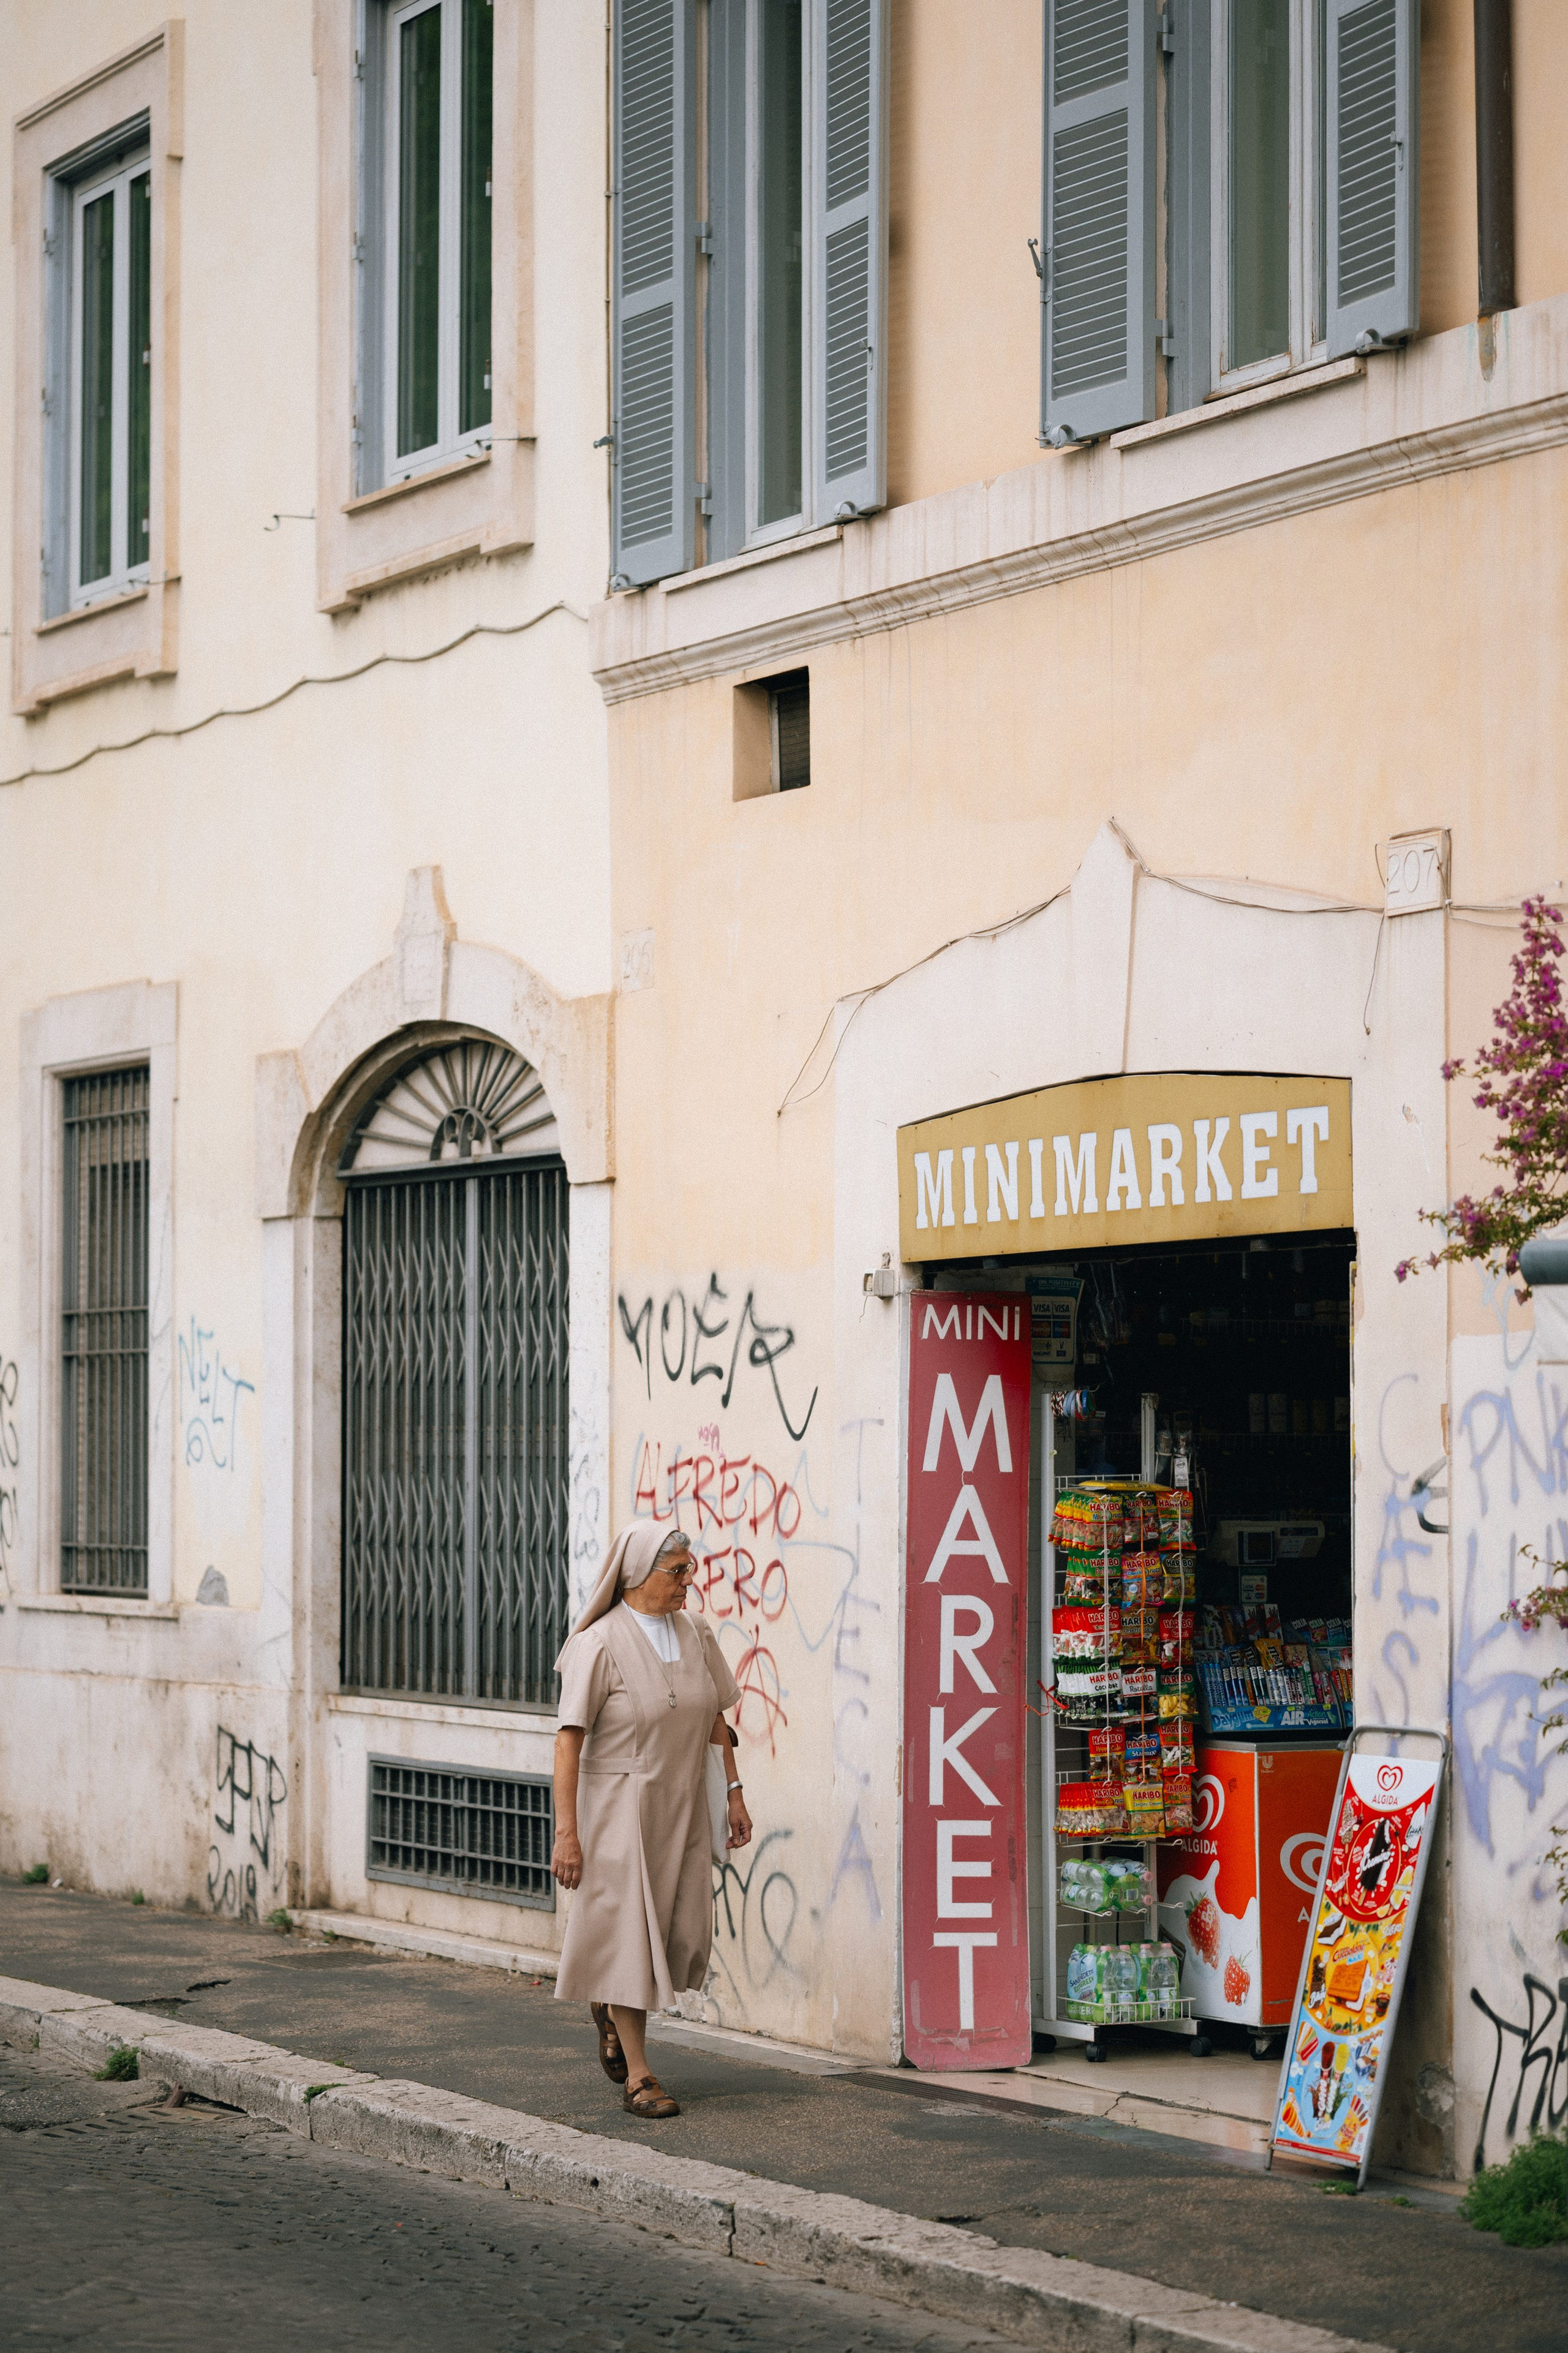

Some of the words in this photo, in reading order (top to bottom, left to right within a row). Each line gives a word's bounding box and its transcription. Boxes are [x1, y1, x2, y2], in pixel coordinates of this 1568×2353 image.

[1387, 847, 1437, 894] 207
[914, 1105, 1329, 1229] MINIMARKET
[1034, 1304, 1050, 1313] VISA
[1054, 1304, 1069, 1313] VISA
[921, 1304, 1021, 1340] MINI
[633, 1441, 801, 1539] ALFREDO
[1090, 1557, 1119, 1568] HARBO
[1126, 1558, 1156, 1569] HARBO
[1088, 1611, 1119, 1623] HARBO
[1090, 1672, 1118, 1683] HARBO
[921, 1372, 1014, 2030] MARKET
[1280, 1711, 1305, 1726] AIR
[1093, 1788, 1120, 1799] HARIBO
[1166, 1784, 1188, 1794] HARIBO
[1133, 1790, 1161, 1801] HARIBO
[1371, 1794, 1398, 1805] ALGIDA
[1181, 1839, 1218, 1856] ALGIDA
